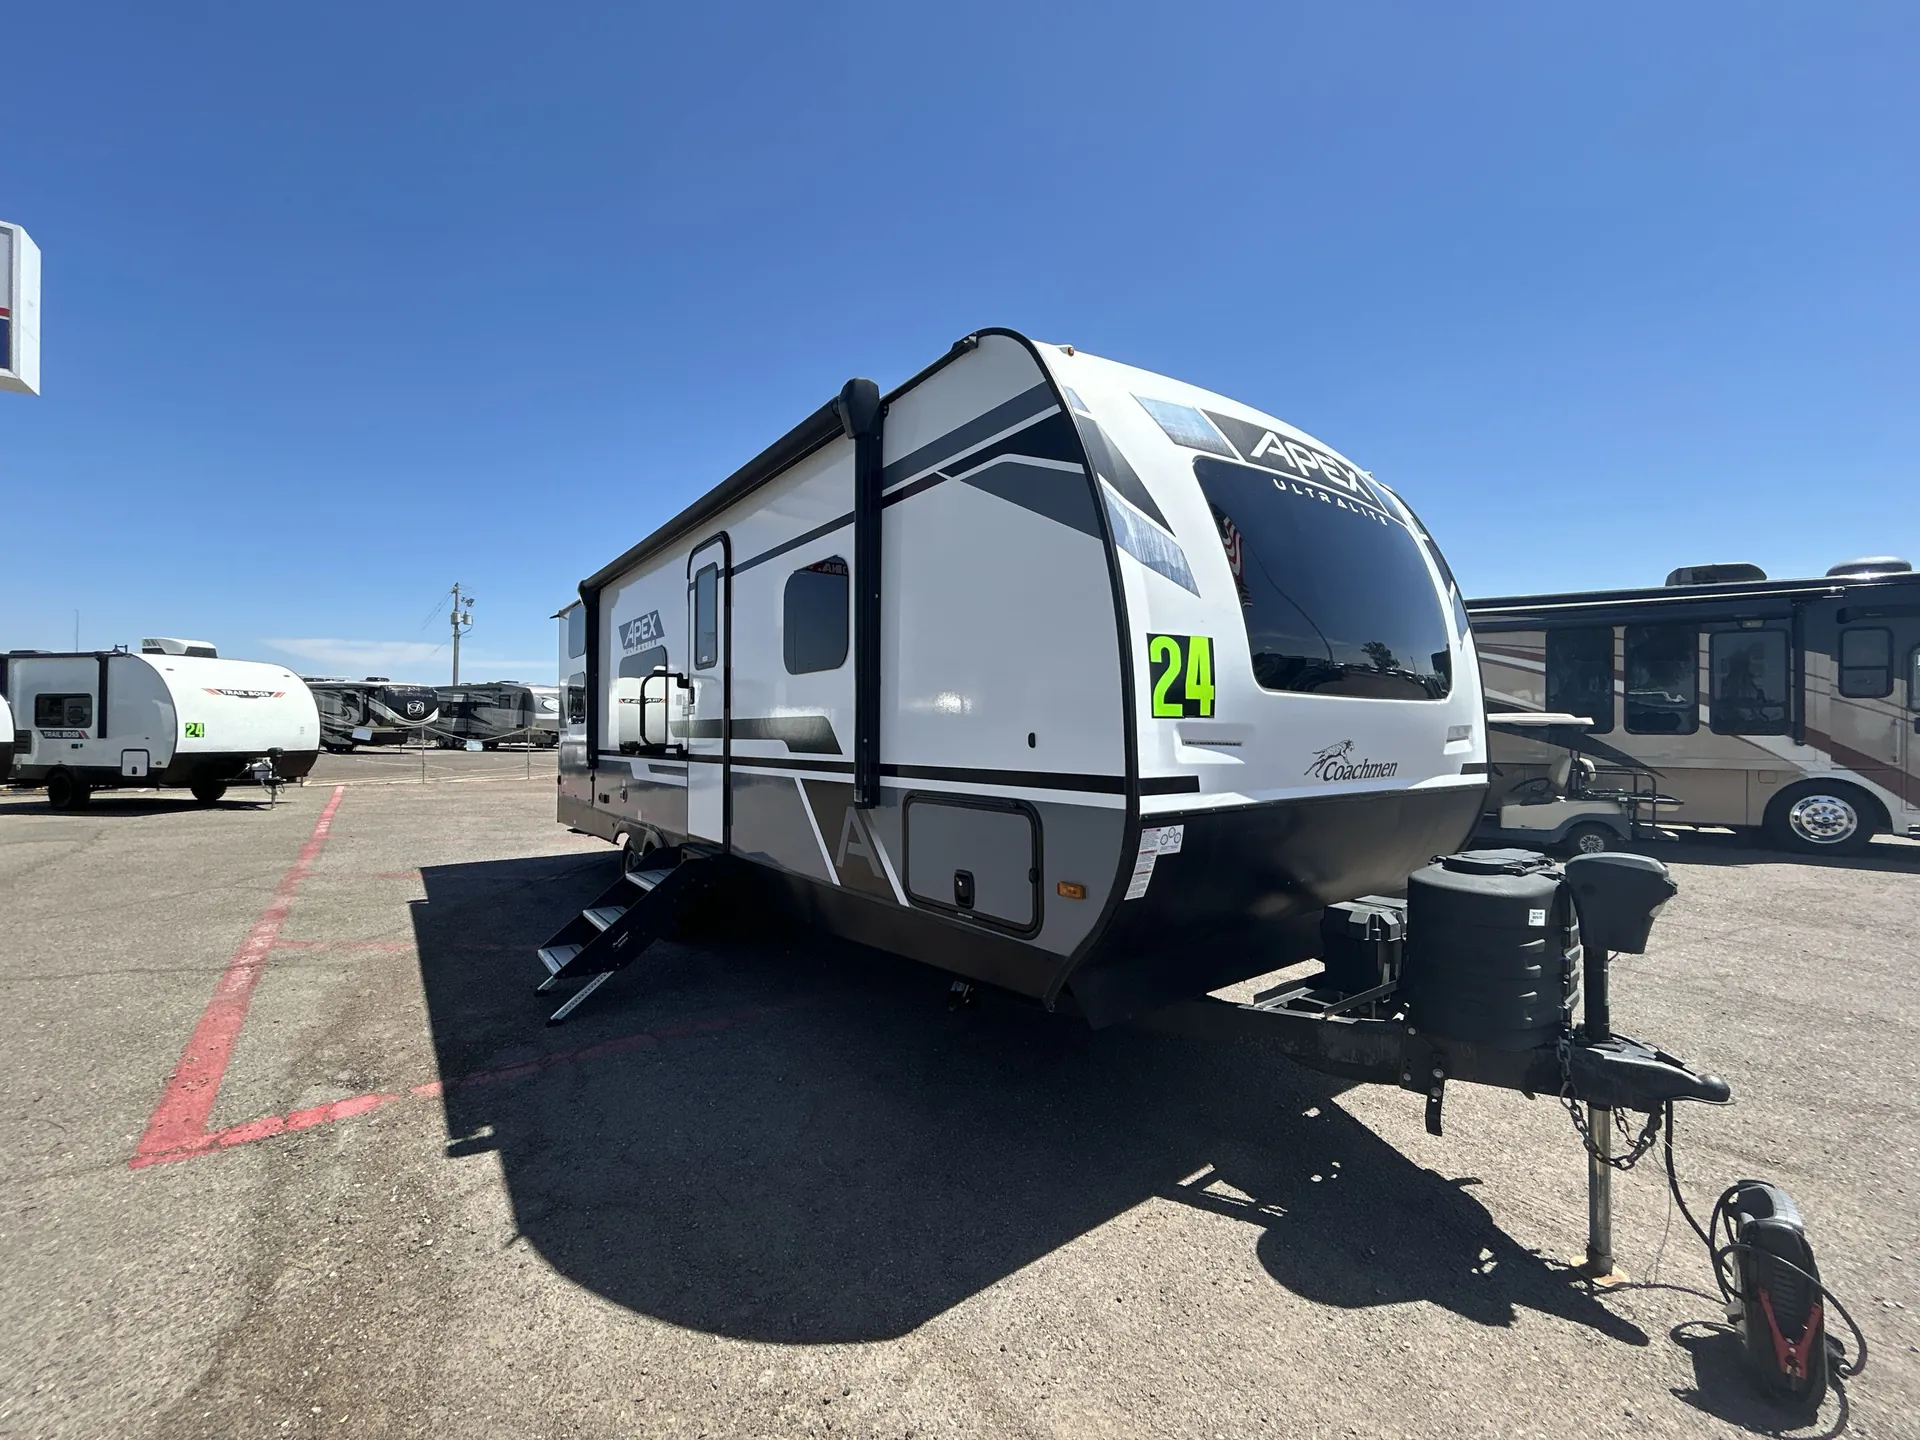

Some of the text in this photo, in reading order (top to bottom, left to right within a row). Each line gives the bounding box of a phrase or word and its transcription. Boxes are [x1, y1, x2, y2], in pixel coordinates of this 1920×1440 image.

[1250, 431, 1373, 501] APEX
[1272, 478, 1388, 526] ULTRALITE
[624, 613, 658, 647] APEX
[1150, 636, 1215, 717] 24
[186, 723, 204, 737] 24
[1322, 758, 1398, 782] Coachmen
